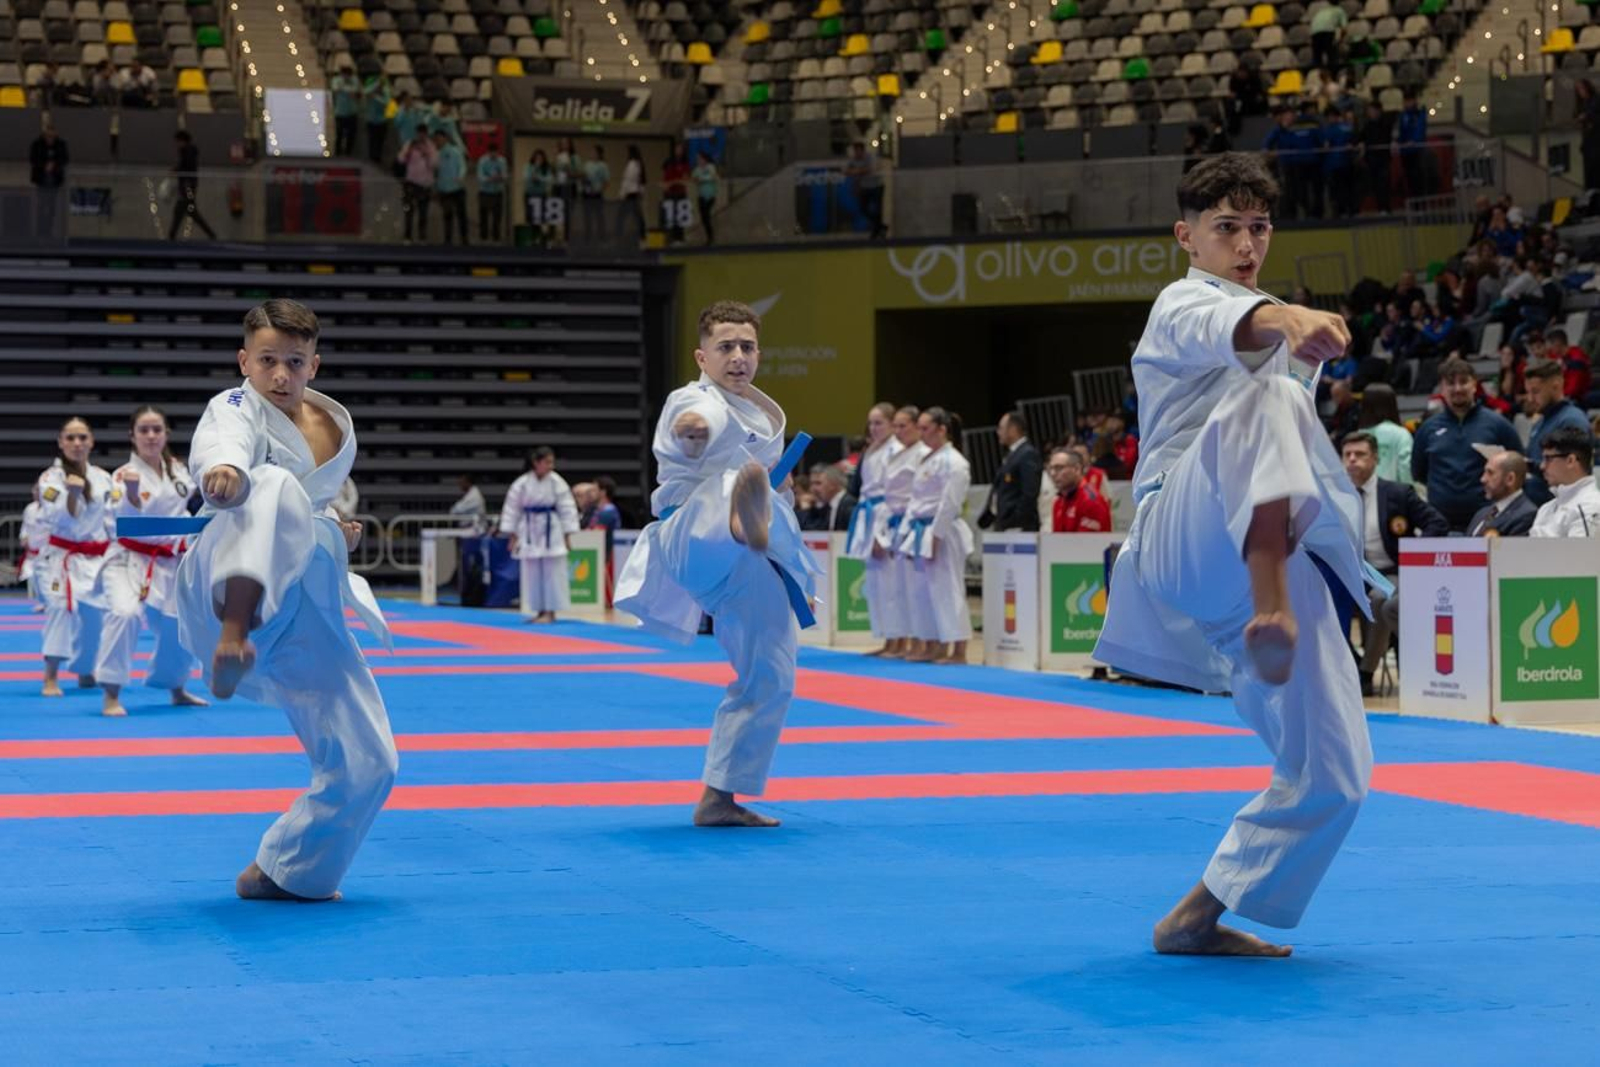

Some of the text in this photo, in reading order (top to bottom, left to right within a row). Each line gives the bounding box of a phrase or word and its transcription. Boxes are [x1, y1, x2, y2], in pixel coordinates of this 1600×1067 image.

[532, 87, 652, 123] Salida 7
[528, 196, 565, 226] 18
[661, 200, 693, 229] 18
[975, 242, 1079, 281] olivo
[1433, 551, 1453, 567] AKA
[1516, 665, 1583, 683] Iberdrola
